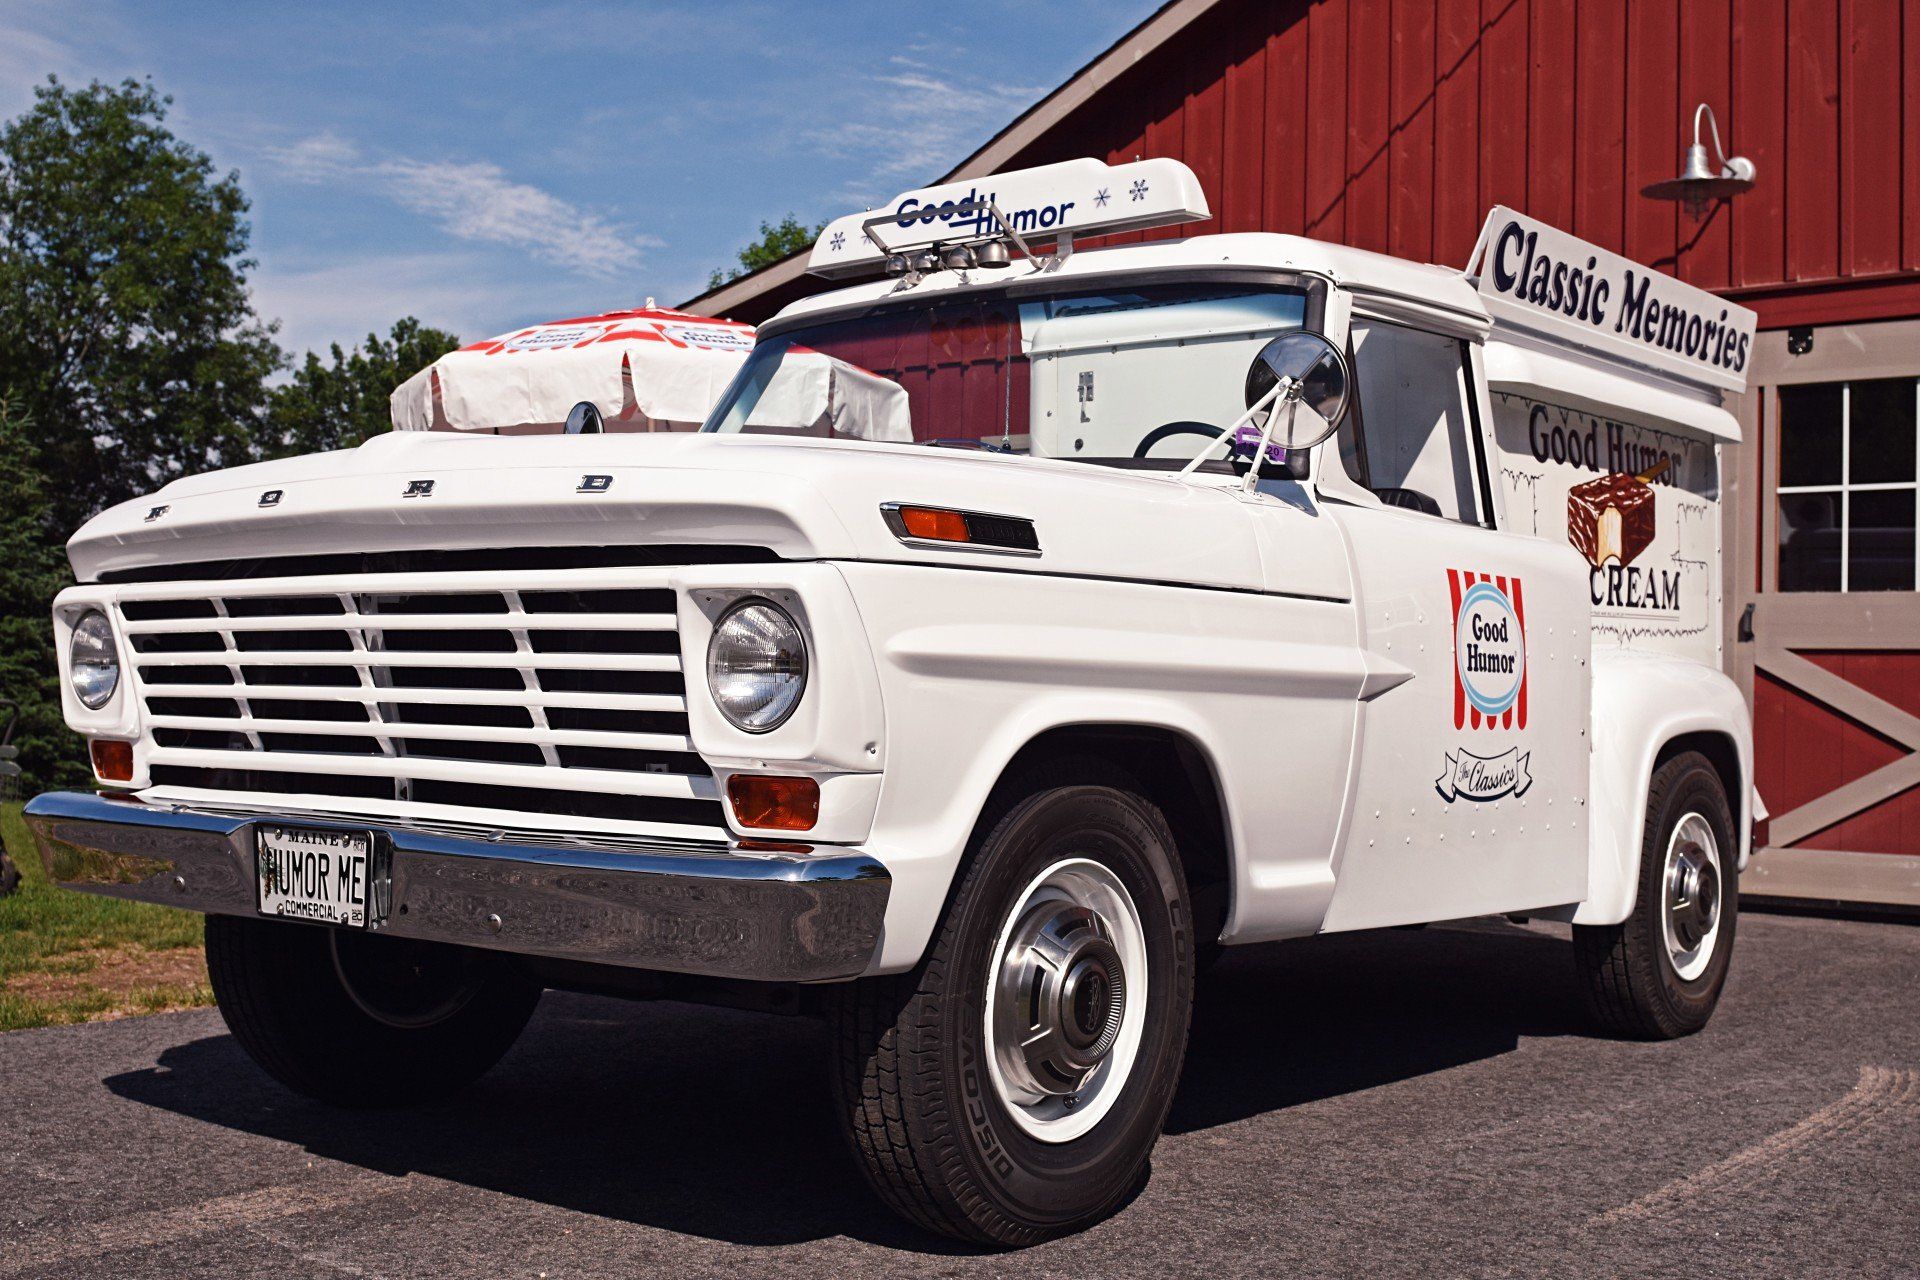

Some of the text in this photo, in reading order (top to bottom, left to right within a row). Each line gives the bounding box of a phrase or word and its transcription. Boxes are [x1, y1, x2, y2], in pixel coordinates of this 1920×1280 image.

[896, 188, 977, 229] Good
[948, 191, 1076, 239] Humor
[1492, 221, 1750, 373] Classic Memories
[1529, 404, 1599, 472] Good
[1590, 564, 1681, 610] CREAM
[1472, 613, 1508, 642] Good
[1466, 643, 1515, 674] Humor
[1458, 760, 1515, 793] The Classics
[288, 831, 339, 846] MAINE
[266, 848, 365, 905] HUMOR ME
[285, 900, 338, 920] COMMERCIAL
[351, 911, 363, 921] 20
